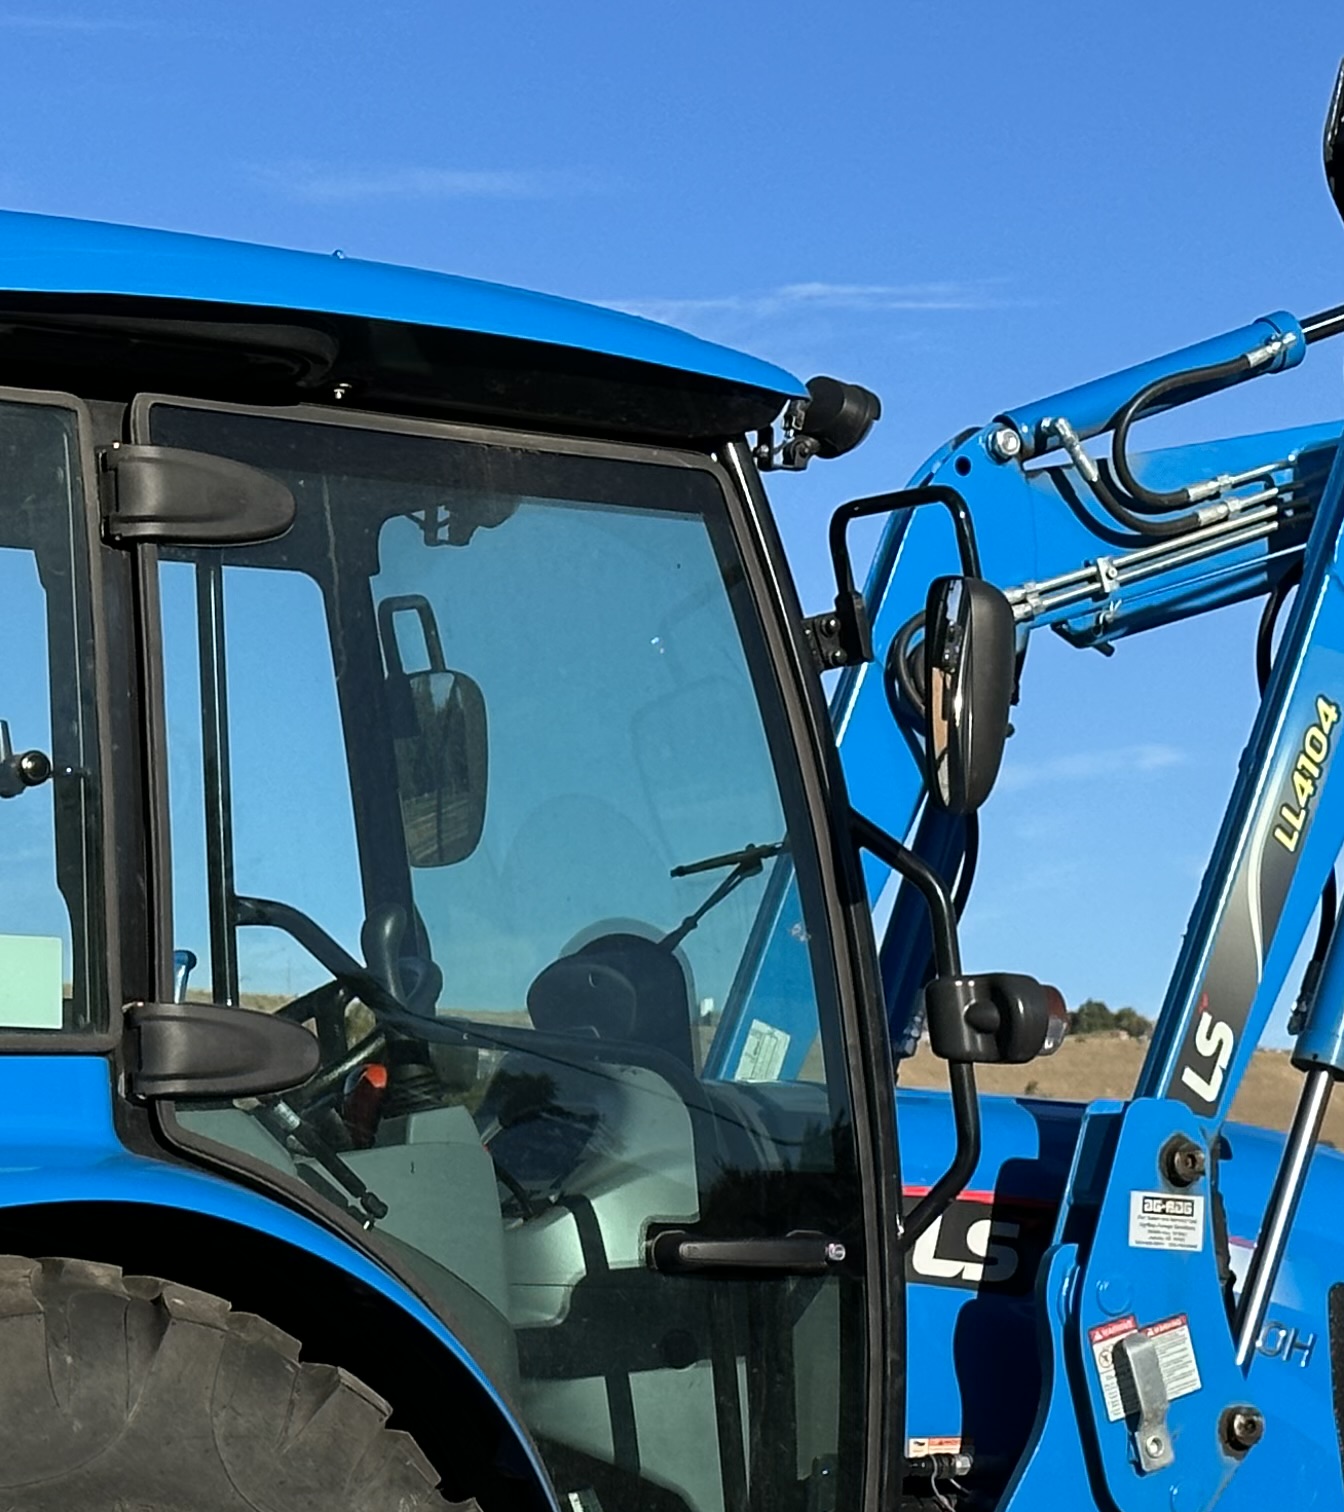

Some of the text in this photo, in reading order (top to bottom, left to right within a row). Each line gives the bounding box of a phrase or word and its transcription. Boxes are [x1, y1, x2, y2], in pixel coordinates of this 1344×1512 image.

[1272, 694, 1343, 853] LL4104
[1181, 1011, 1235, 1103] LS
[912, 1213, 1020, 1283] LS
